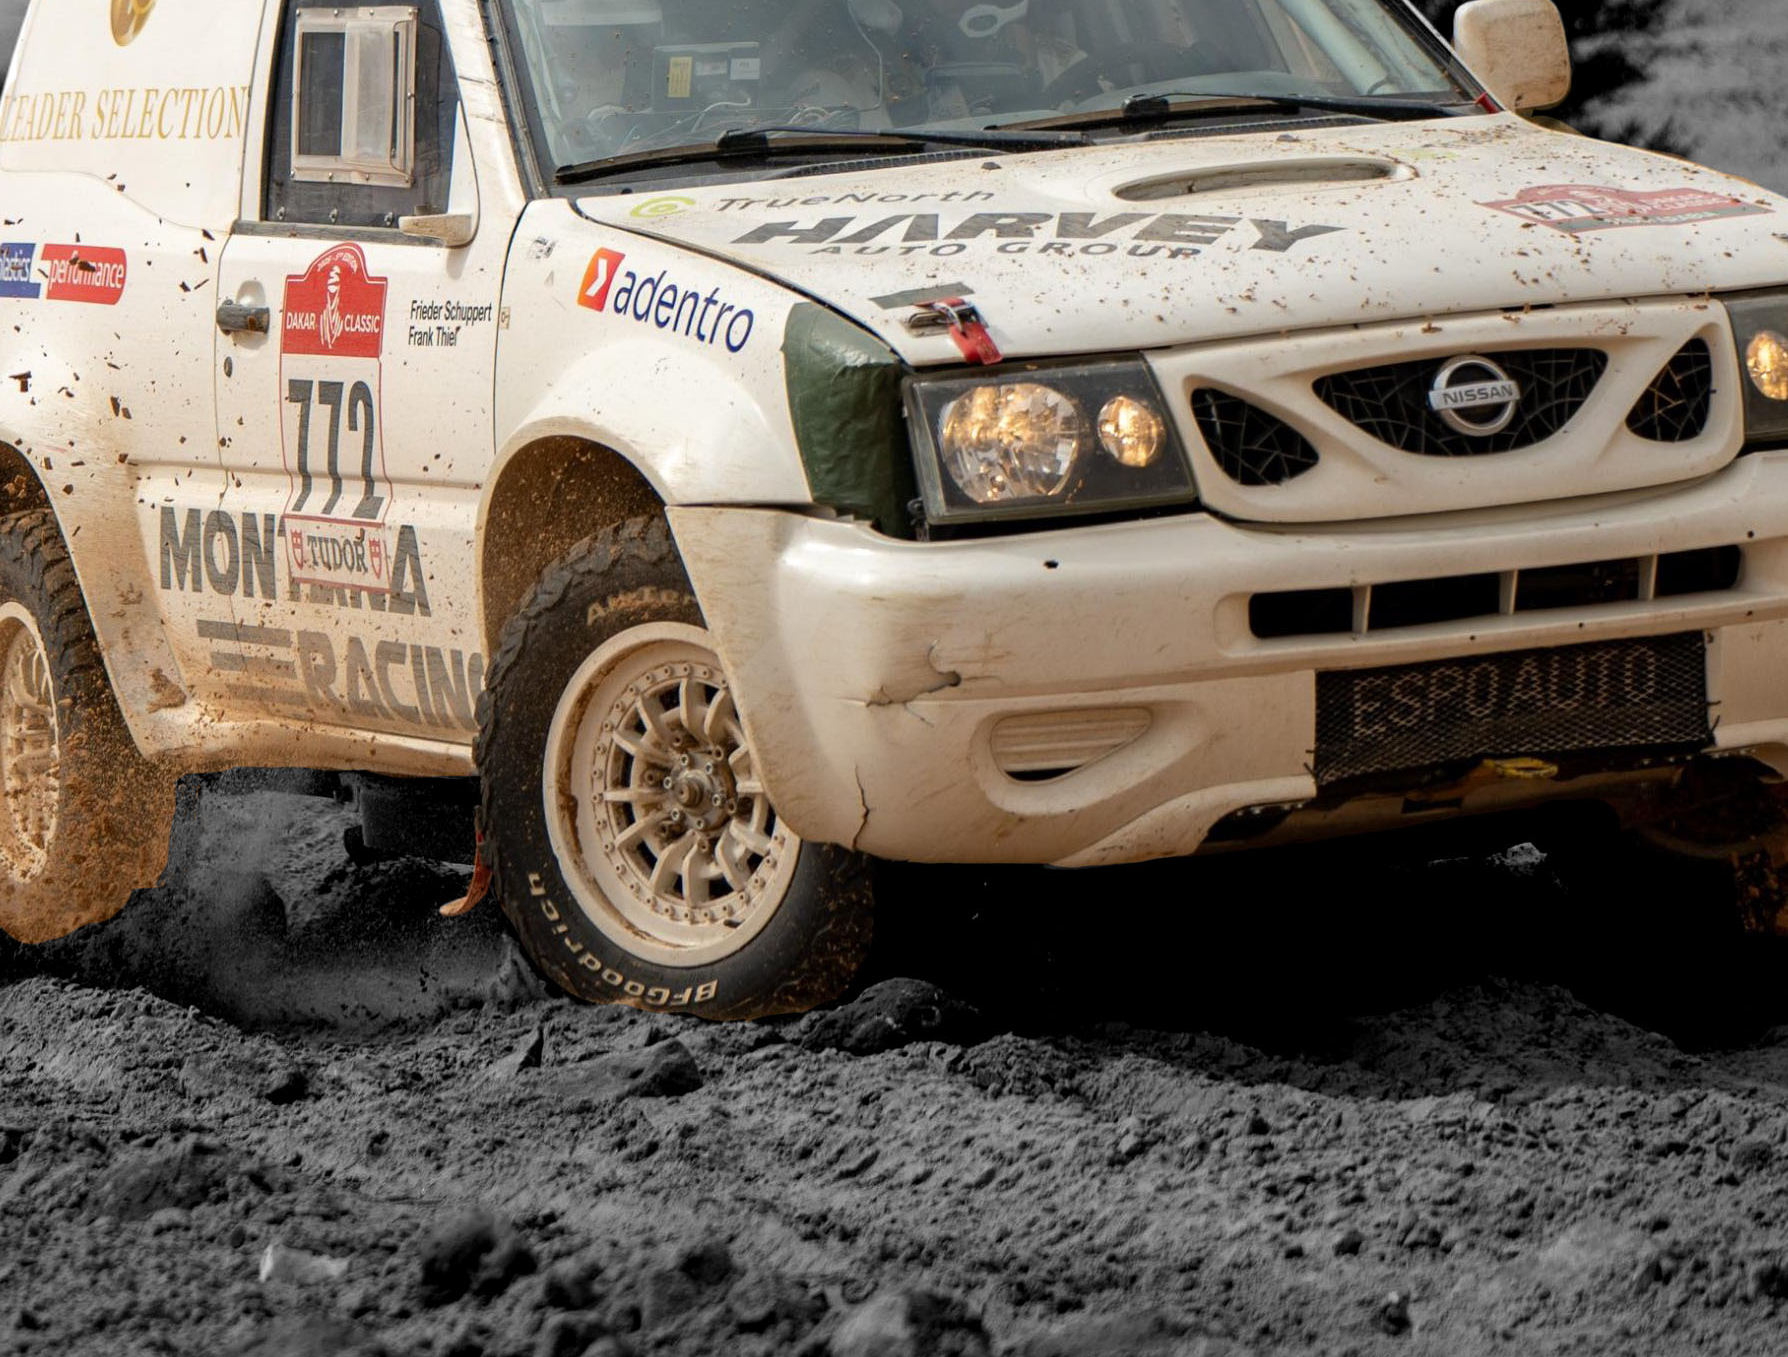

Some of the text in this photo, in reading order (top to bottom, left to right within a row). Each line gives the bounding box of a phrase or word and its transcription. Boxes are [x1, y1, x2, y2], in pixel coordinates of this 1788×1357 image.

[0, 85, 250, 142] LEADER SELECTION
[717, 190, 996, 212] TrueNorth
[729, 212, 1349, 253] HARVEY
[808, 241, 1202, 259] AUTO GROUP
[286, 312, 381, 334] DAKAR CLASSIC
[410, 299, 492, 327] Frieder Schuppert
[613, 269, 754, 353] adentro
[408, 325, 434, 347] Frank
[1442, 384, 1514, 405] NISSAN
[288, 378, 385, 520] 772
[306, 533, 369, 574] TUDOR
